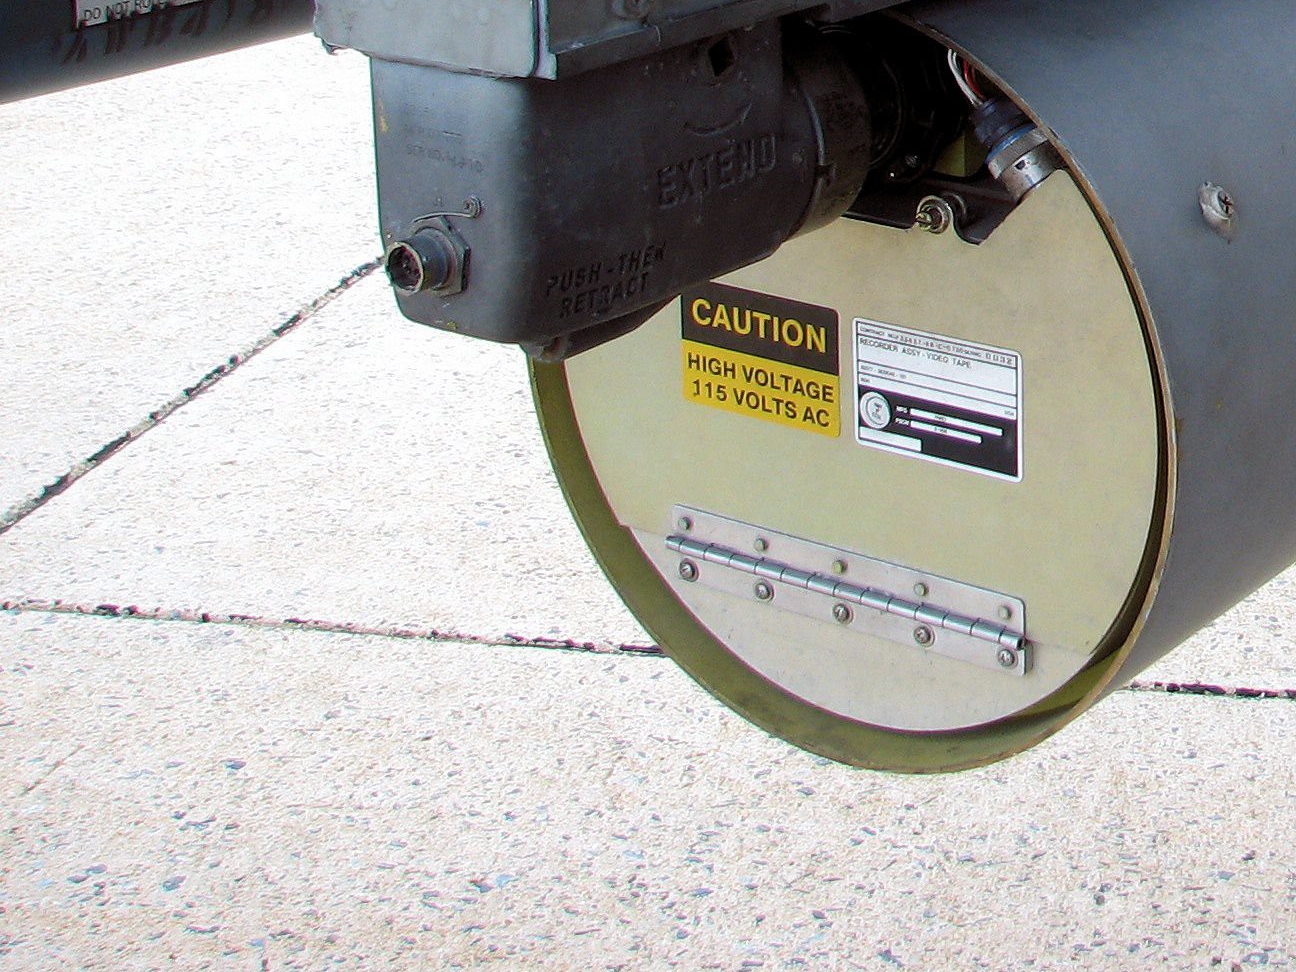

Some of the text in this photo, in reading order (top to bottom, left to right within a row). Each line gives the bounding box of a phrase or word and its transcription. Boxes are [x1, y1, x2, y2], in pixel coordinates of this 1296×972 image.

[84, 8, 102, 21] DO
[106, 0, 130, 17] NOT
[657, 134, 777, 209] EXTEND
[560, 271, 649, 318] RETRACT
[691, 298, 827, 354] CAUTION
[687, 351, 736, 379] HIGH
[742, 364, 834, 403] VOLTAGE
[693, 379, 830, 428] 115 VOLTS AC
